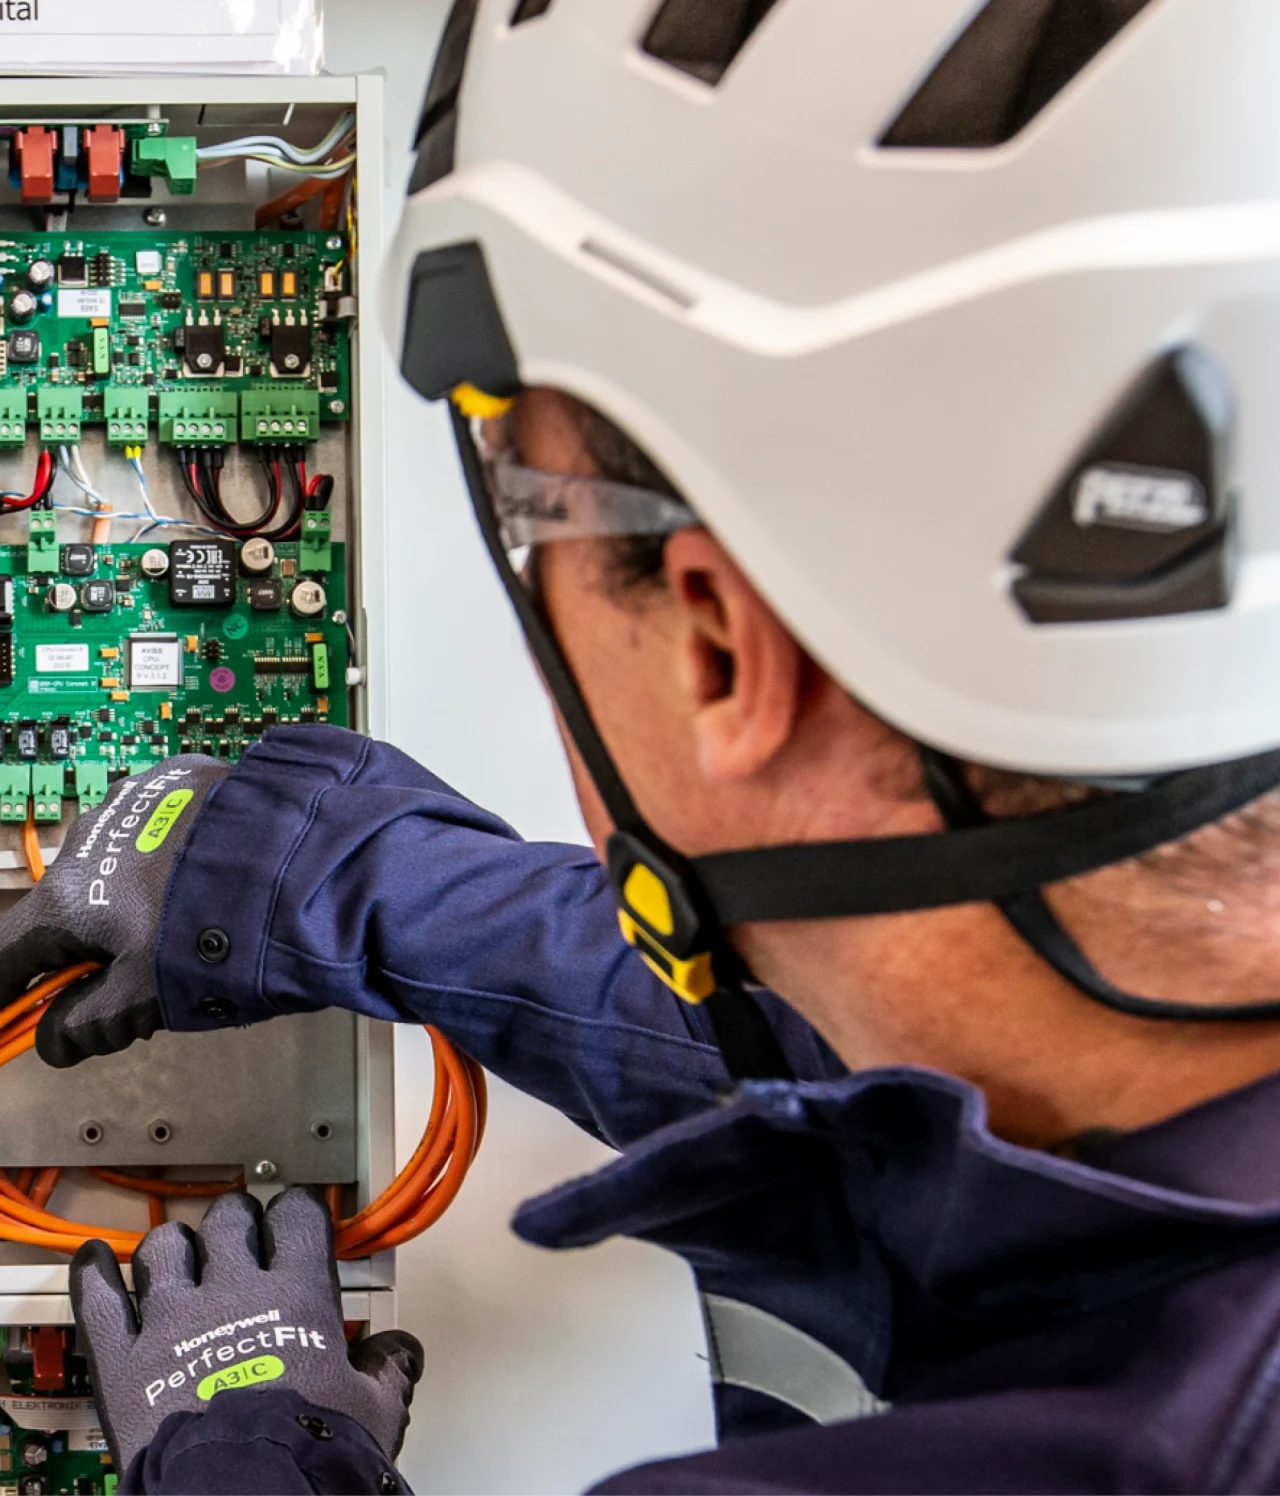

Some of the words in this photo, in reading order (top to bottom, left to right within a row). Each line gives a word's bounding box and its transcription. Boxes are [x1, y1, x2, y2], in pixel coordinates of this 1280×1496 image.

[225, 618, 245, 637] NC
[89, 768, 192, 906] PerfectFit
[173, 1309, 281, 1357] Honeywell
[145, 1326, 326, 1407] PerfectFit
